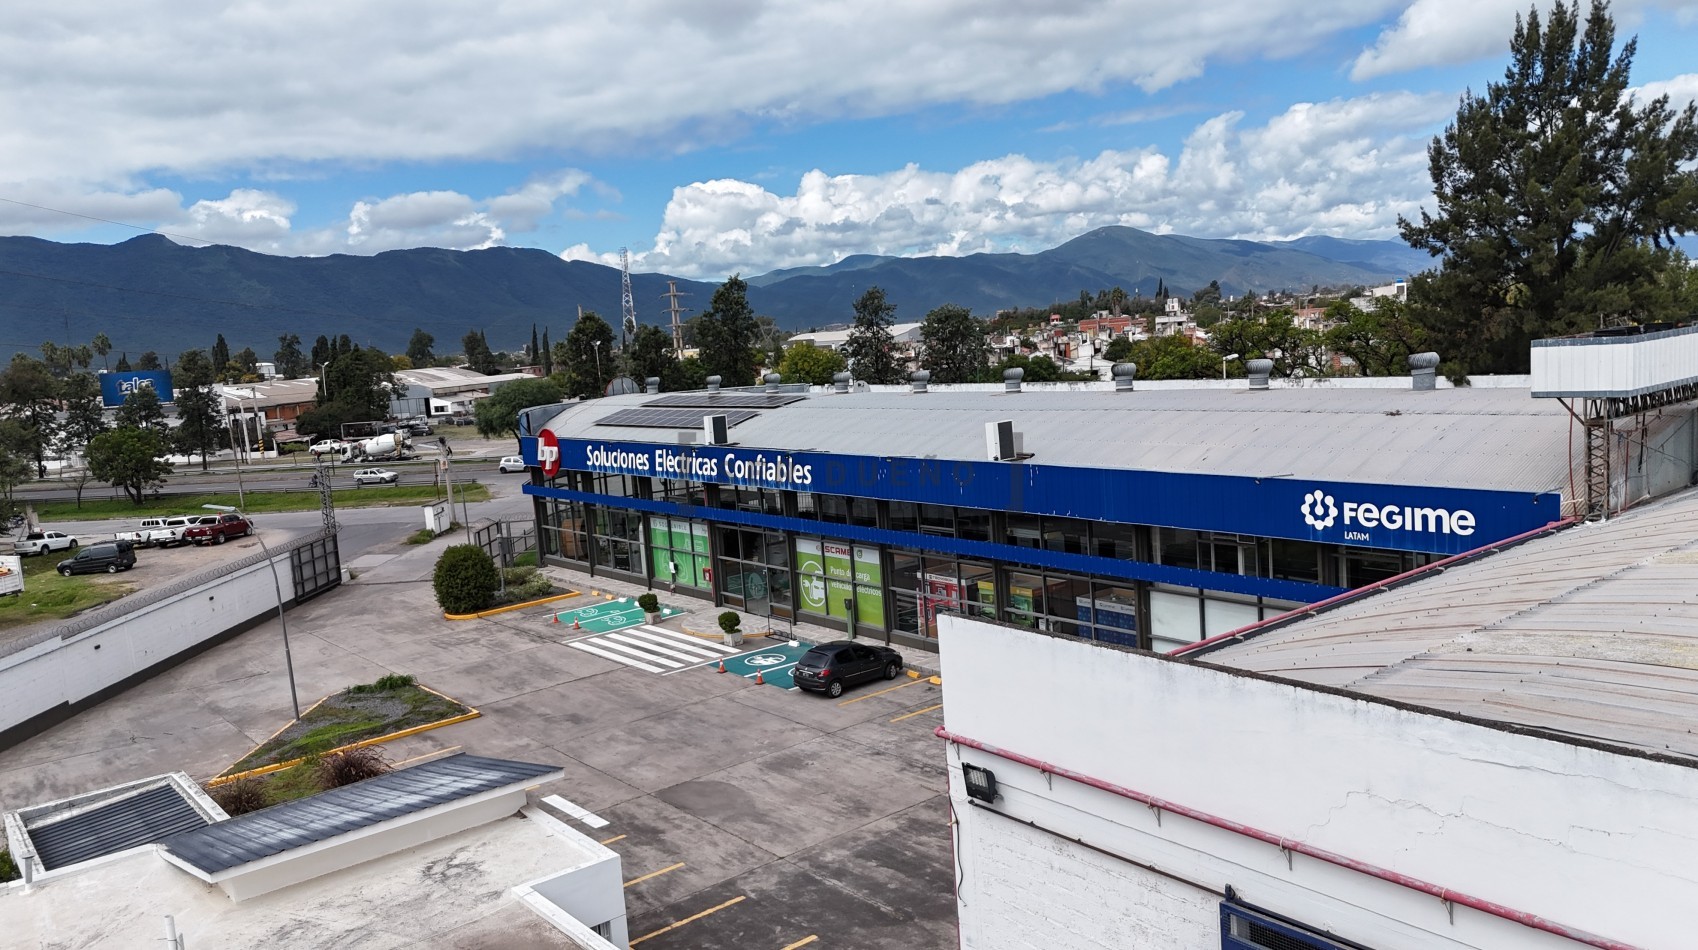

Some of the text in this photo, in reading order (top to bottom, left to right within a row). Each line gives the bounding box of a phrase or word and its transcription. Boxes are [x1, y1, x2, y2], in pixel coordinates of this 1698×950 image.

[538, 437, 558, 470] bp
[586, 445, 649, 471] Soluciones
[724, 453, 812, 484] Confiables
[1344, 531, 1370, 541] LATAM
[825, 546, 851, 556] SCAME
[830, 566, 870, 582] Punto d carga
